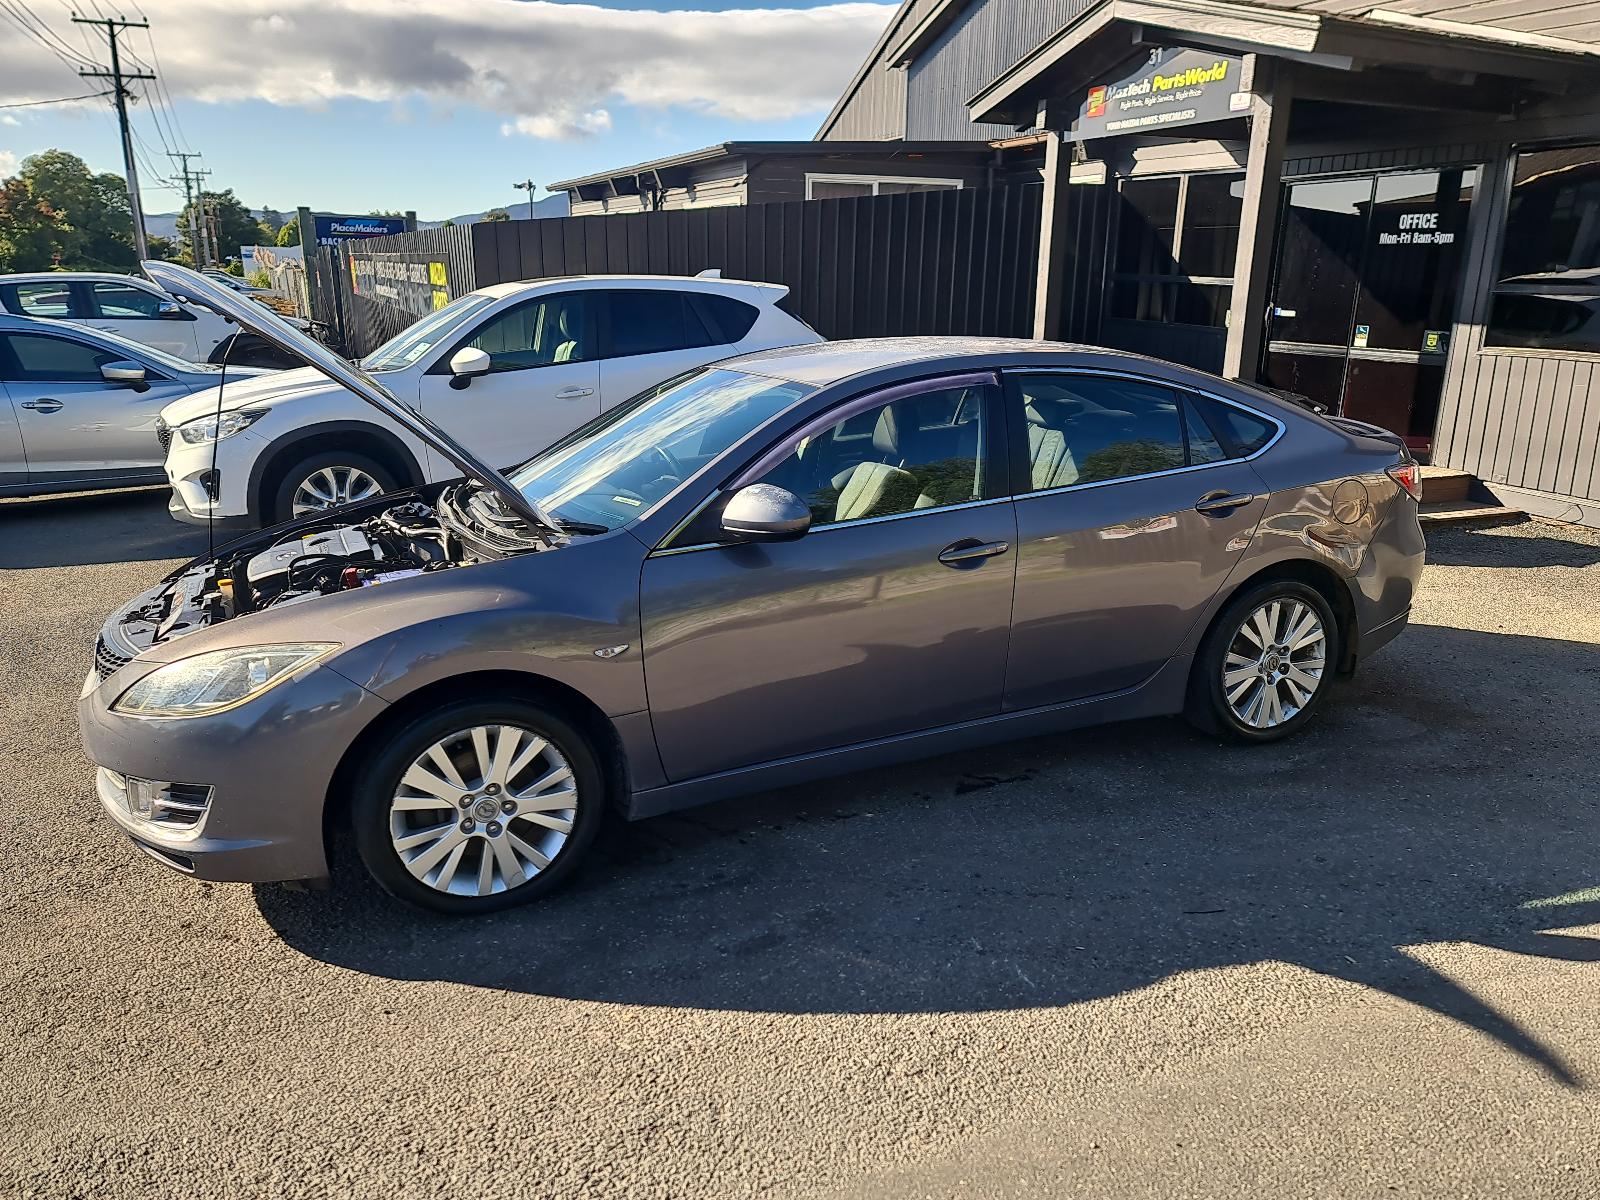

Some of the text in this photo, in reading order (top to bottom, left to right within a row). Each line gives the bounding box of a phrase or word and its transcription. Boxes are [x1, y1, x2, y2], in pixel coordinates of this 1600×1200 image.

[1148, 47, 1164, 66] 31
[1106, 60, 1229, 101] MazTech PartsWorld
[330, 223, 388, 233] PlaceMakers
[1399, 213, 1439, 229] OFFICE
[1379, 231, 1455, 245] Mon-Fri 8am-5pm
